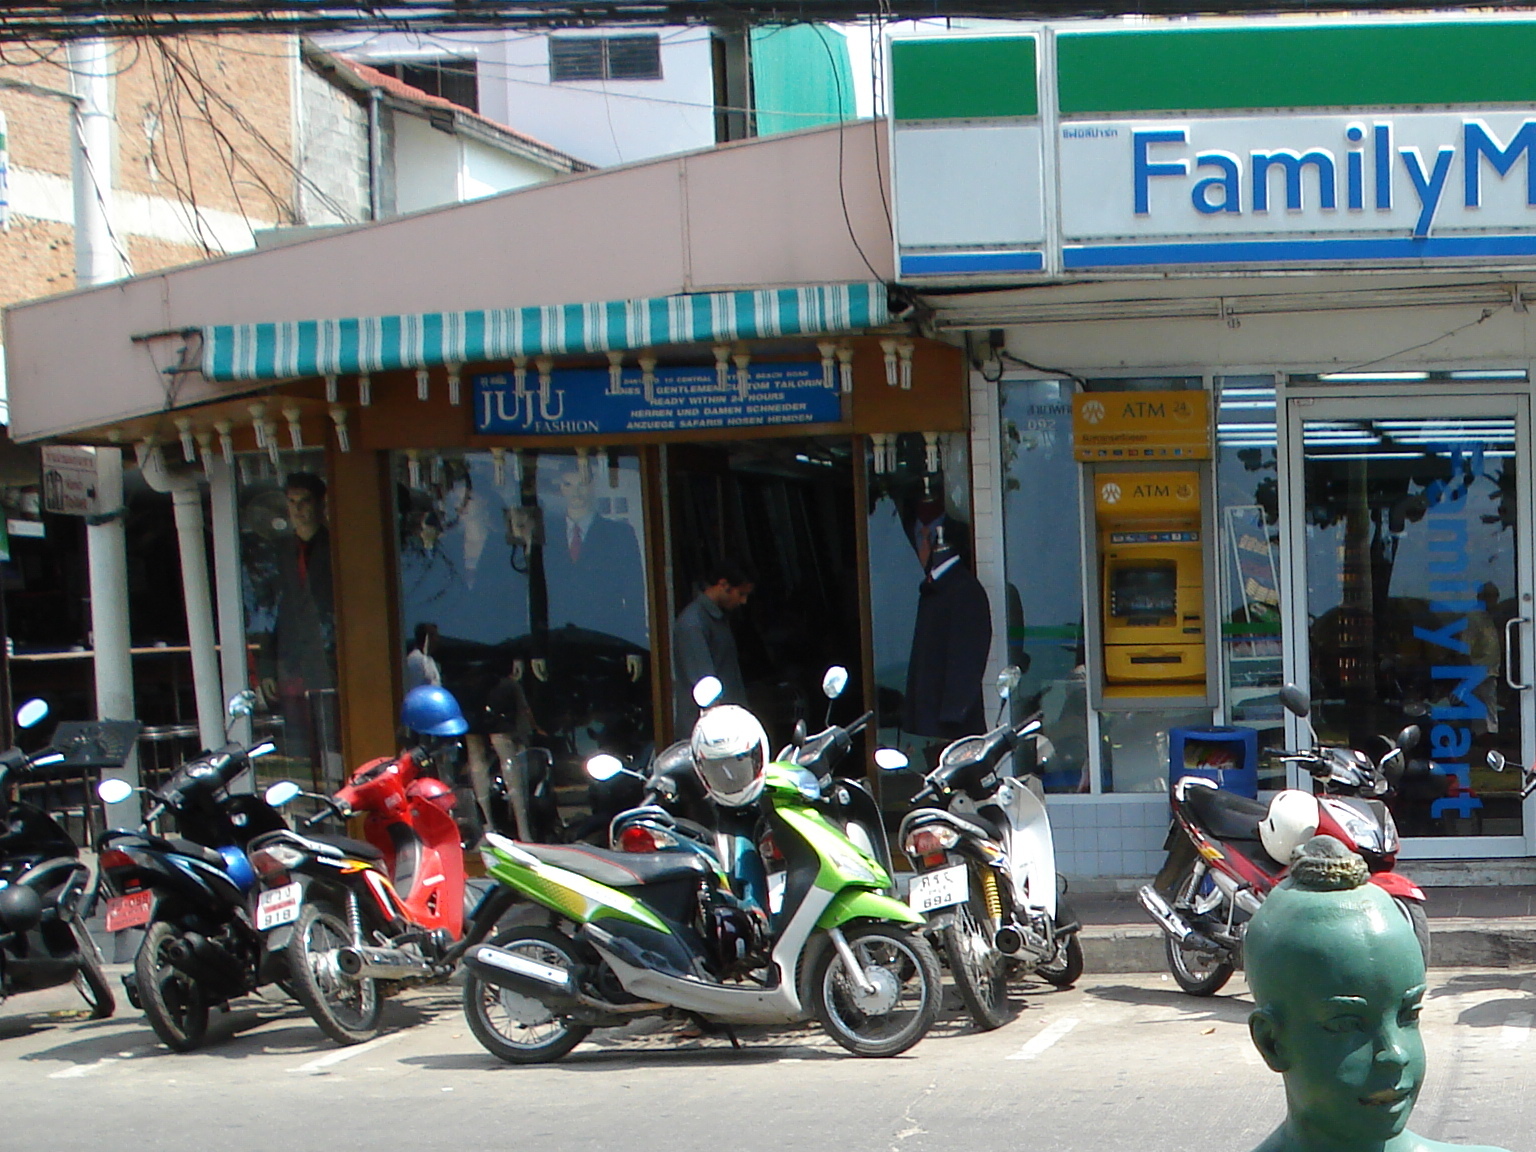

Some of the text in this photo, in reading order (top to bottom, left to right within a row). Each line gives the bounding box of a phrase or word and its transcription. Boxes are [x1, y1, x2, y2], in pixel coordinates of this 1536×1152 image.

[786, 370, 810, 378] ROAD
[605, 387, 641, 396] LDIES
[727, 381, 770, 390] CUTOM
[774, 378, 827, 389] TAILORIN
[650, 397, 685, 406] READY
[688, 396, 727, 405] WITHIN
[748, 393, 785, 402] HOURS
[480, 390, 565, 429] JUJU
[631, 403, 807, 418] HERREN UND DAMEN SCHNEIDER
[1122, 402, 1166, 418] ATM
[534, 420, 599, 433] FASHION
[626, 414, 813, 429] ANZUEGE SAFARIS HOSEN HEMDEN
[1133, 484, 1170, 498] ATM
[1413, 441, 1485, 820] FamilyMart
[923, 893, 952, 909] 694
[264, 908, 292, 927] 918
